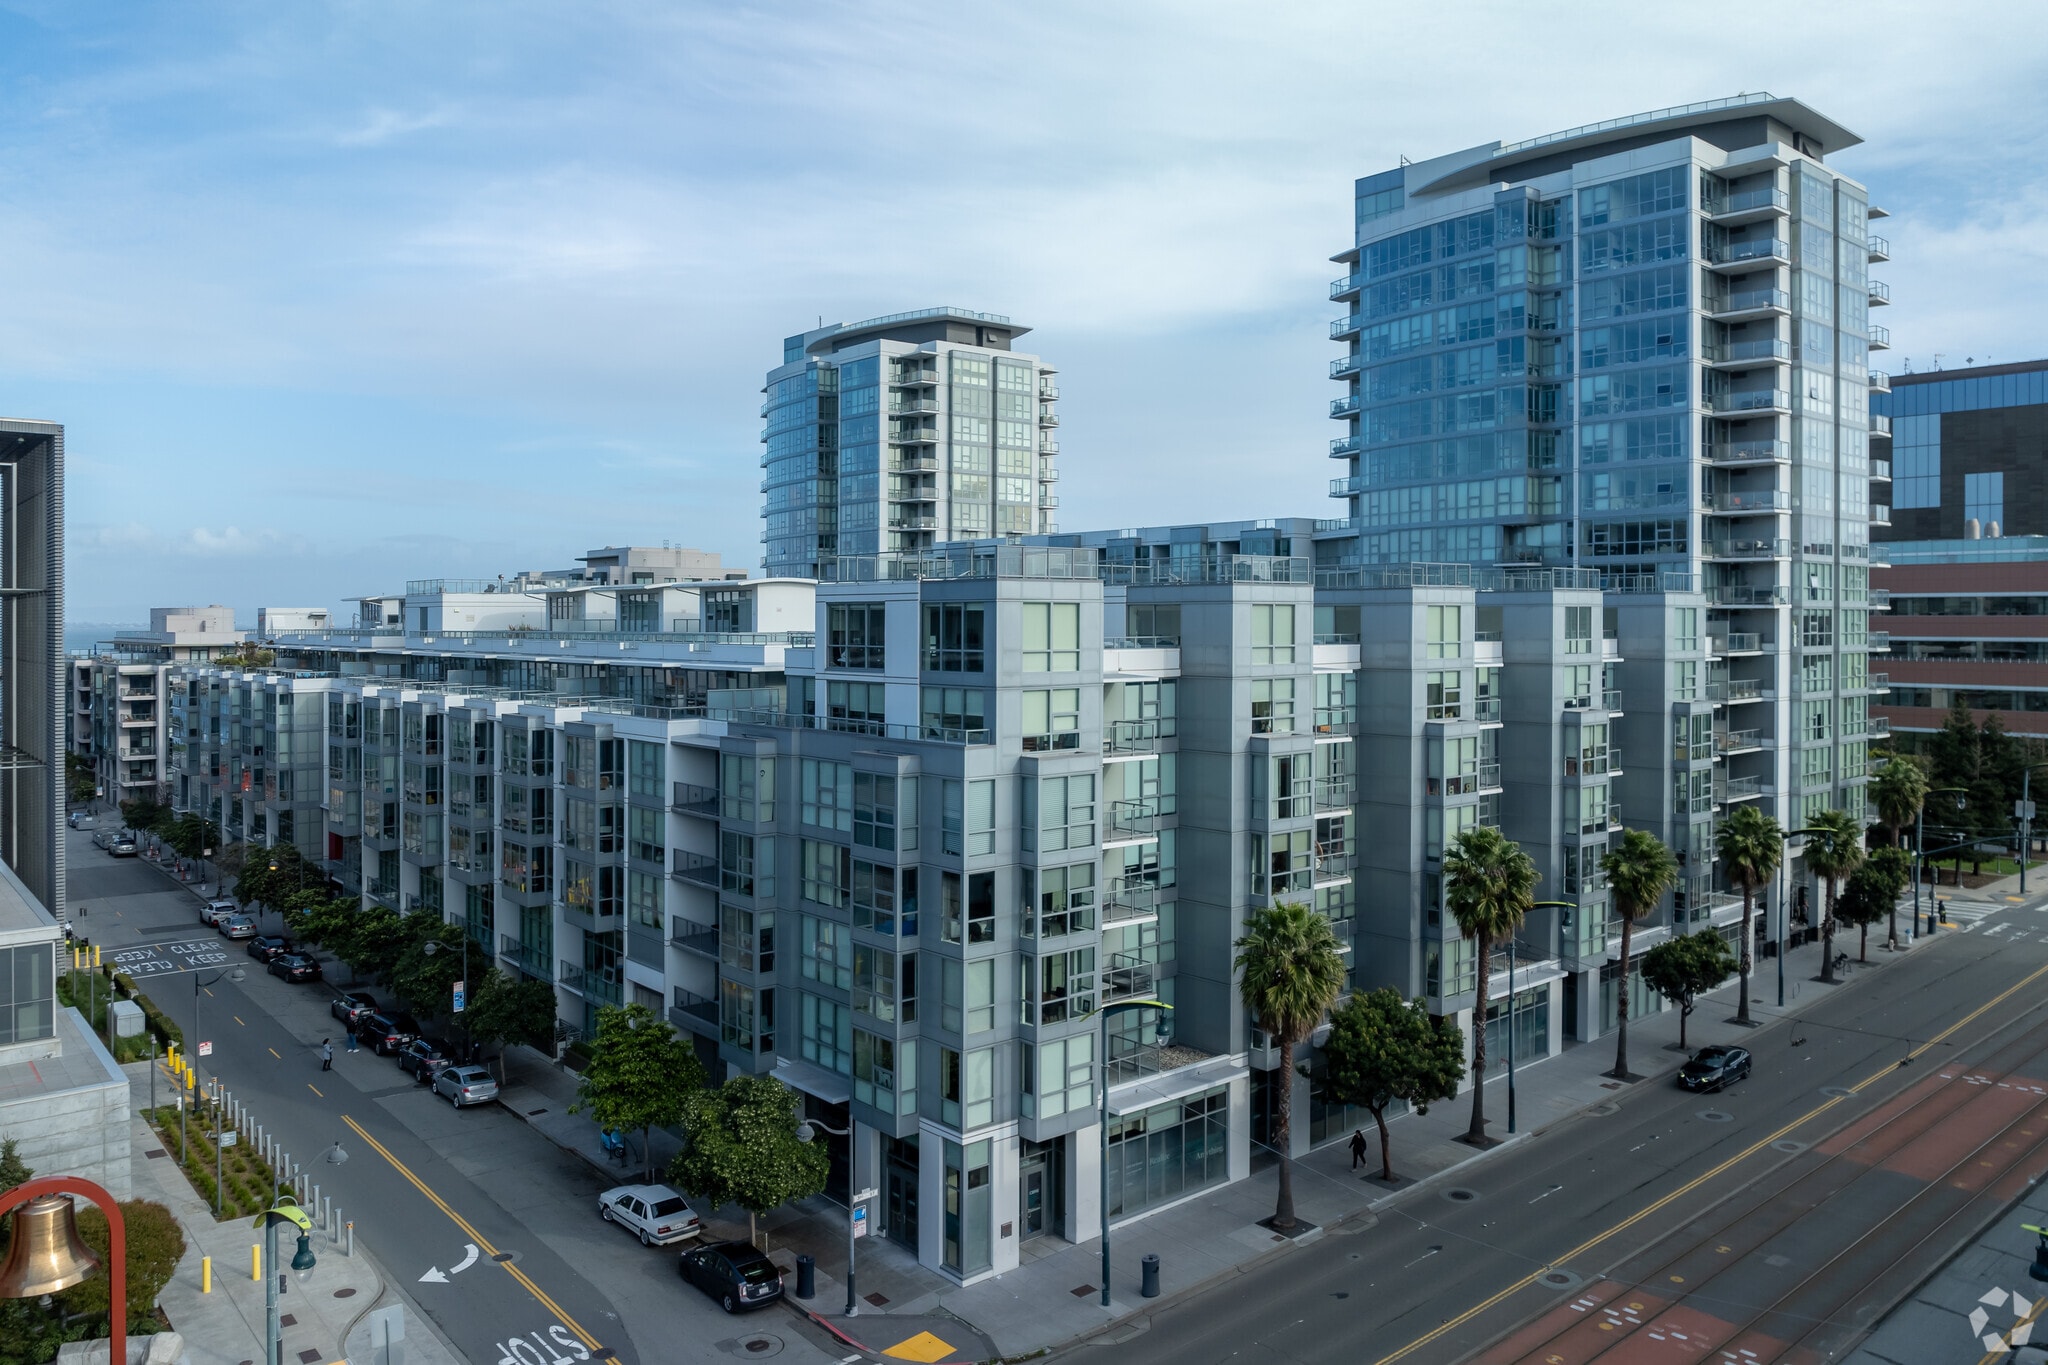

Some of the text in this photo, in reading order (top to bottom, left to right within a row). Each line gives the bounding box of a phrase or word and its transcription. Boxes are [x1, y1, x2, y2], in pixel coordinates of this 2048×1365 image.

[170, 941, 224, 954] CLEAR
[114, 949, 156, 963] KEEP
[185, 952, 228, 966] KEEP
[117, 960, 173, 975] CLEAR
